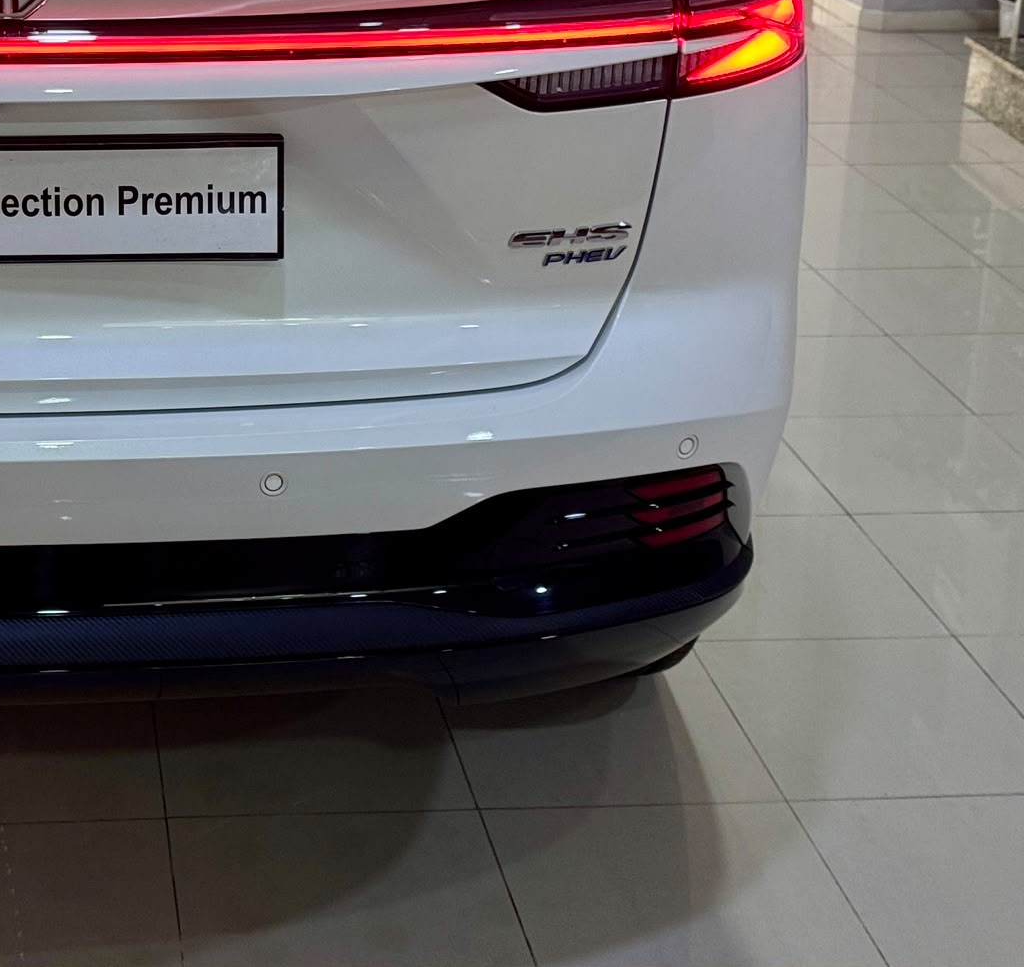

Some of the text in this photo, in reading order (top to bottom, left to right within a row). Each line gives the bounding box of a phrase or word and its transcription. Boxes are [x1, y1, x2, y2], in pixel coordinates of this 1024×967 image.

[118, 184, 268, 217] Premium
[508, 221, 632, 249] EHS
[542, 245, 628, 267] PHEV
